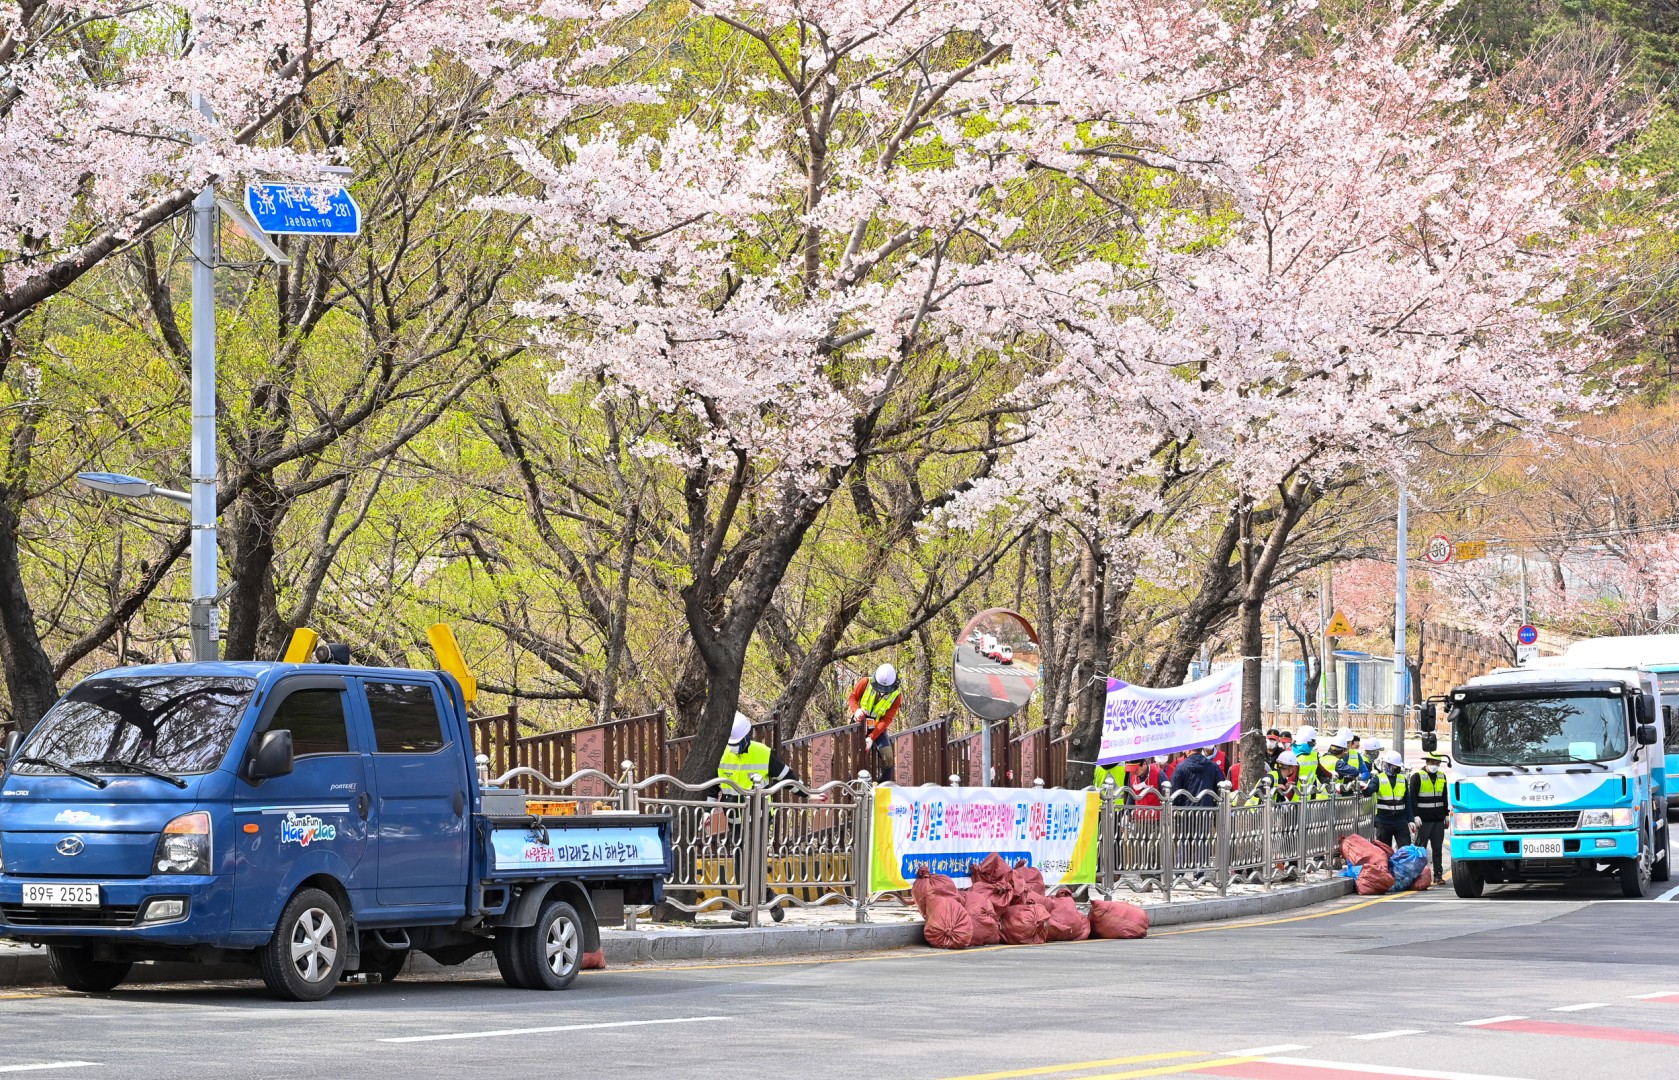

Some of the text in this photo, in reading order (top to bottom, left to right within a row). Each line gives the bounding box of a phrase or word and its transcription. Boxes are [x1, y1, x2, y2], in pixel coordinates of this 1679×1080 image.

[333, 203, 351, 217] 281
[285, 215, 332, 228] Jaeban-ro
[1431, 542, 1446, 557] 30
[290, 816, 318, 827] Sun&Fun
[907, 801, 920, 841] 3월
[920, 801, 943, 841] 24일은
[1029, 801, 1053, 841] 대청소를
[525, 841, 638, 863] 사람중심 미래도시 해운대
[29, 886, 93, 902] 89두 2525
